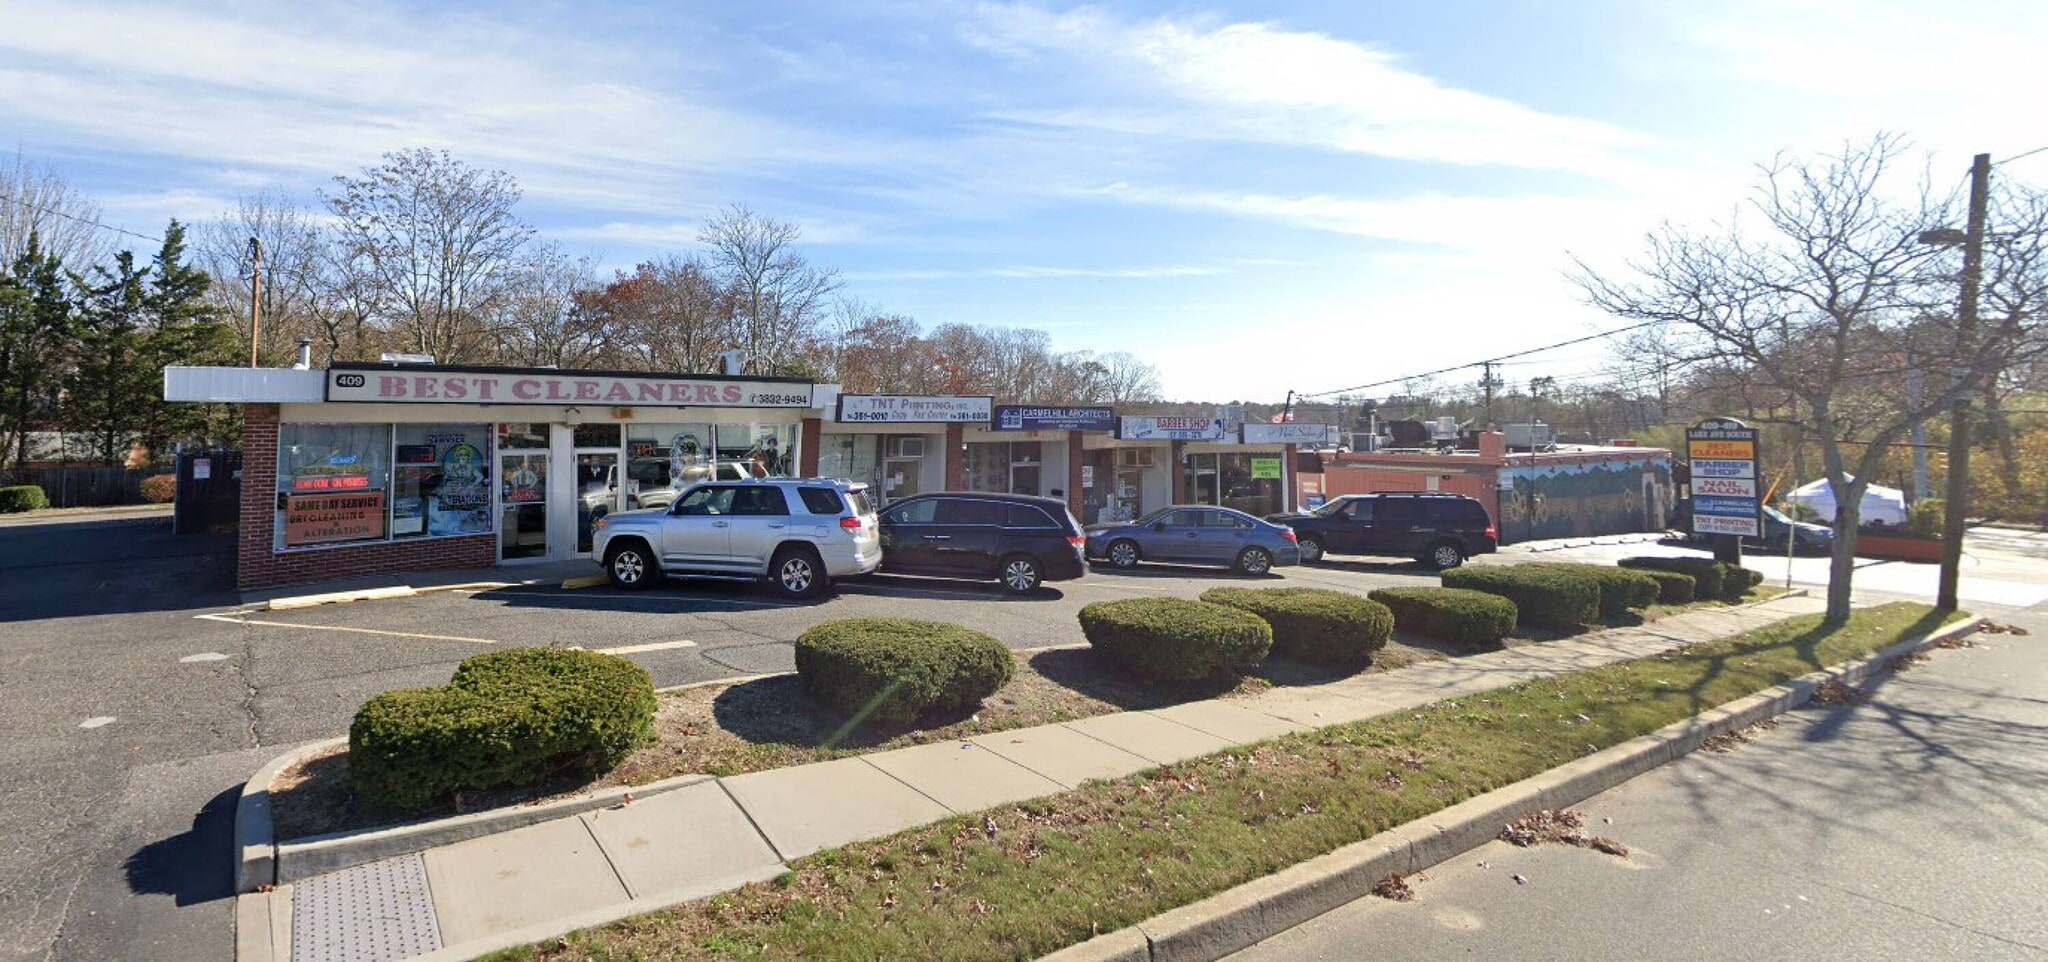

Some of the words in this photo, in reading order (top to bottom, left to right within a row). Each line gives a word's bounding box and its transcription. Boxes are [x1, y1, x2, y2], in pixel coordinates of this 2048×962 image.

[338, 376, 363, 386] 409
[378, 375, 498, 400] BEST
[511, 379, 743, 403] CLEANERS
[870, 398, 895, 409] TNT
[1068, 409, 1111, 418] ARCHITECTS
[1156, 417, 1188, 428] BARBER
[1190, 418, 1210, 428] SHOP
[1692, 449, 1751, 457] CLEANERS
[1703, 468, 1741, 476] SHOP
[1703, 480, 1740, 488] NAIL
[1697, 486, 1750, 495] SALON
[295, 500, 322, 512] SAME
[322, 499, 338, 510] DAY
[341, 497, 378, 509] SERVICE
[290, 514, 307, 524] DRY
[308, 511, 365, 523] CLEANING
[1714, 518, 1754, 527] PRINTING
[303, 526, 369, 538] ALTERATION
